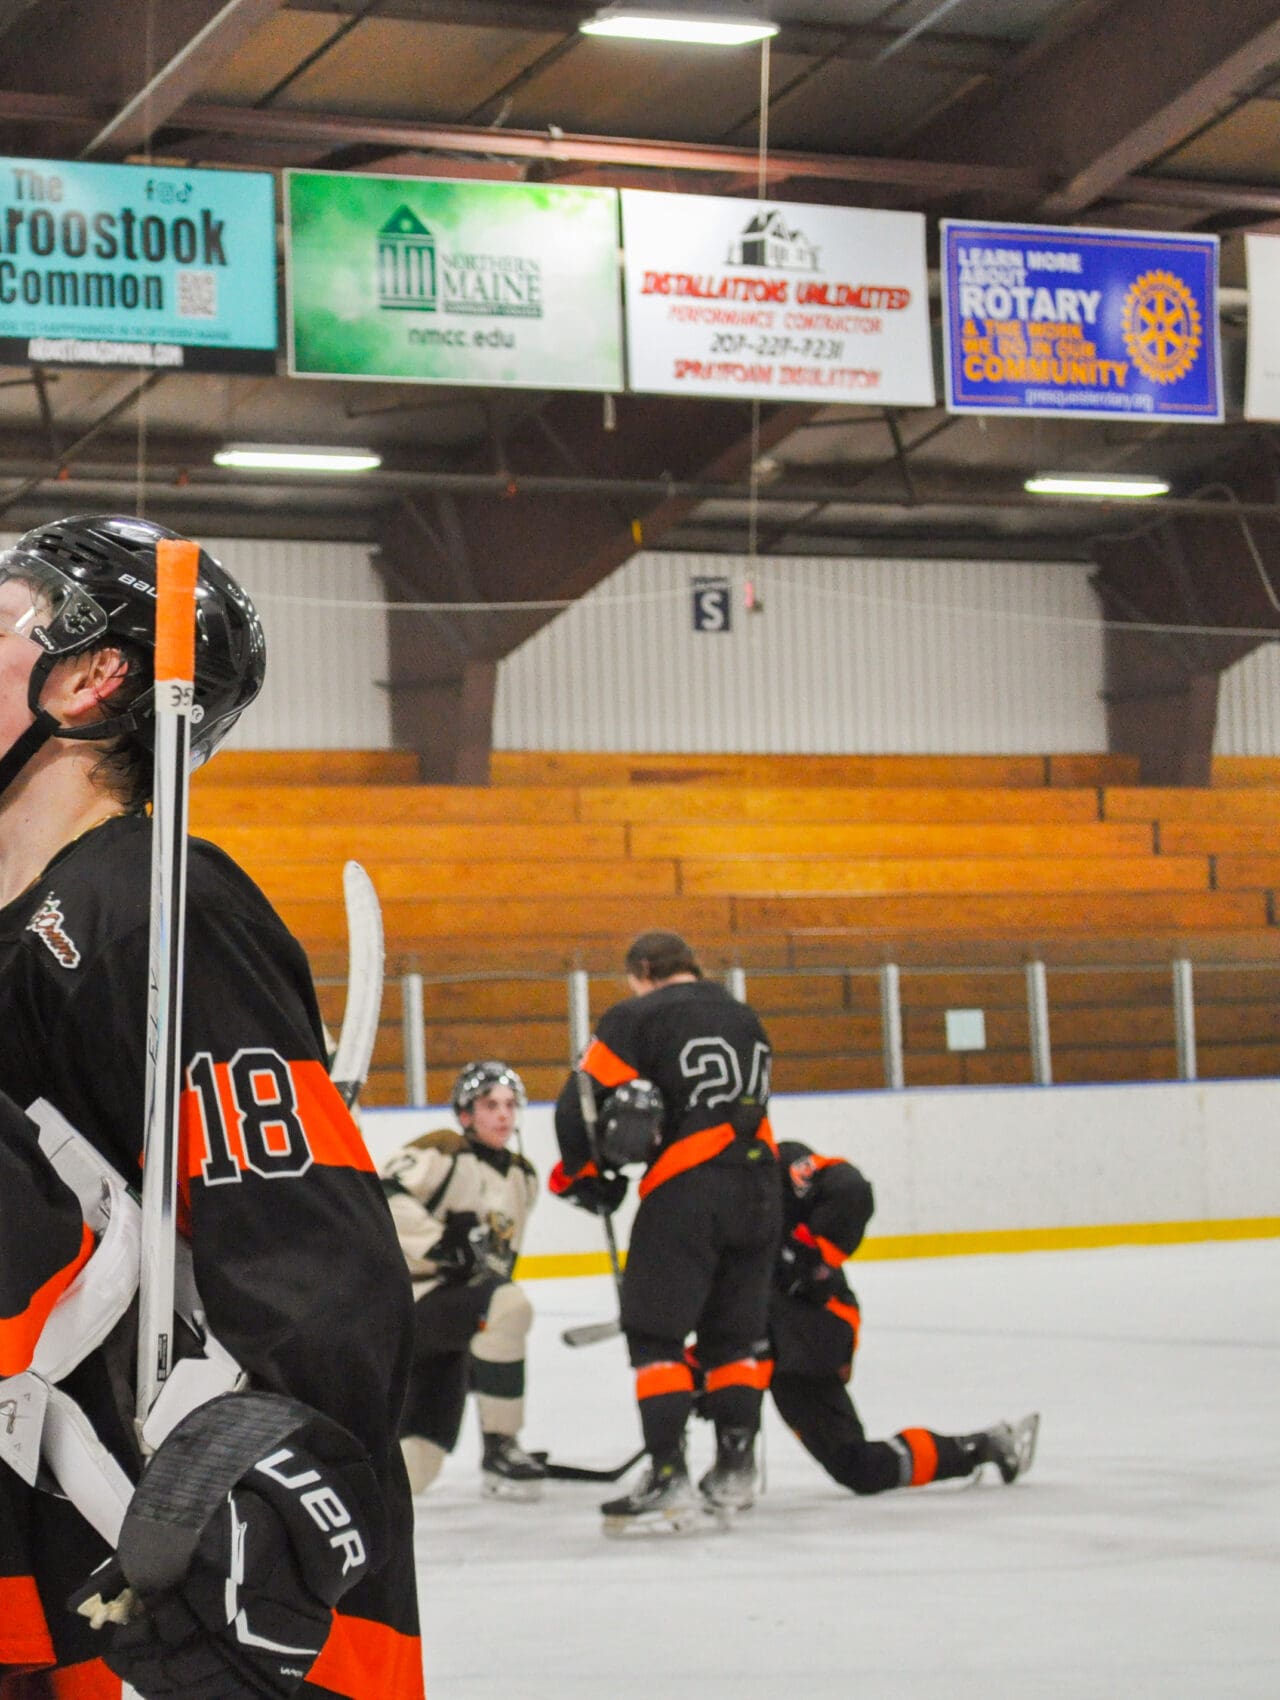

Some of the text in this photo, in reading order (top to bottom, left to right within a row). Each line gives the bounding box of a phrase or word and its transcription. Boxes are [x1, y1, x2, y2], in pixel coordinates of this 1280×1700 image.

[13, 168, 63, 202] The
[959, 248, 1083, 273] LEARN MORE
[960, 266, 1027, 287] ABOUT
[443, 270, 541, 303] MAINE
[641, 271, 912, 310] INSTALLATIONS UNLIMITED
[960, 284, 1101, 323] ROTARY
[408, 327, 516, 349] nmcc.edu
[784, 311, 883, 334] CONTRACTOR
[964, 355, 1128, 387] COMMUNITY
[118, 573, 158, 598] BAU
[700, 592, 725, 629] S
[34, 627, 55, 650] CCM
[186, 1047, 315, 1187] 18
[254, 1448, 367, 1577] UER
